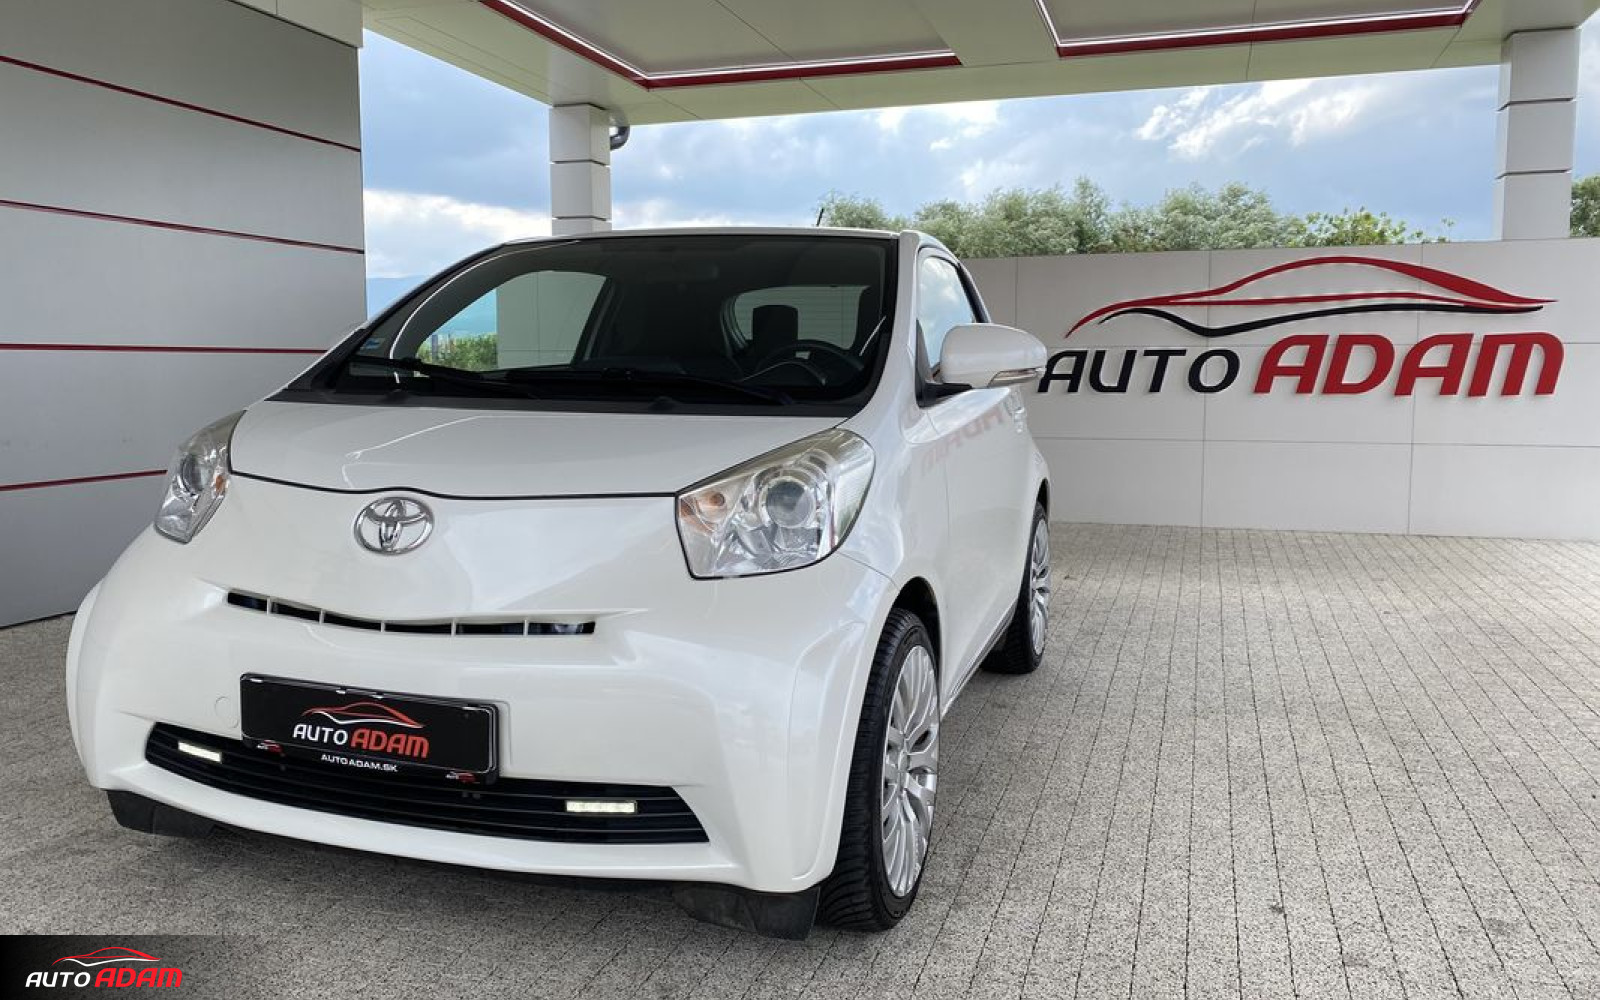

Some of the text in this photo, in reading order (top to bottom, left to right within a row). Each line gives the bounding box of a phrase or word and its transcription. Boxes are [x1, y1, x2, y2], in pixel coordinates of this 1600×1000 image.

[1037, 332, 1566, 397] AUTO ADAM
[292, 722, 430, 759] AUTO ADAM
